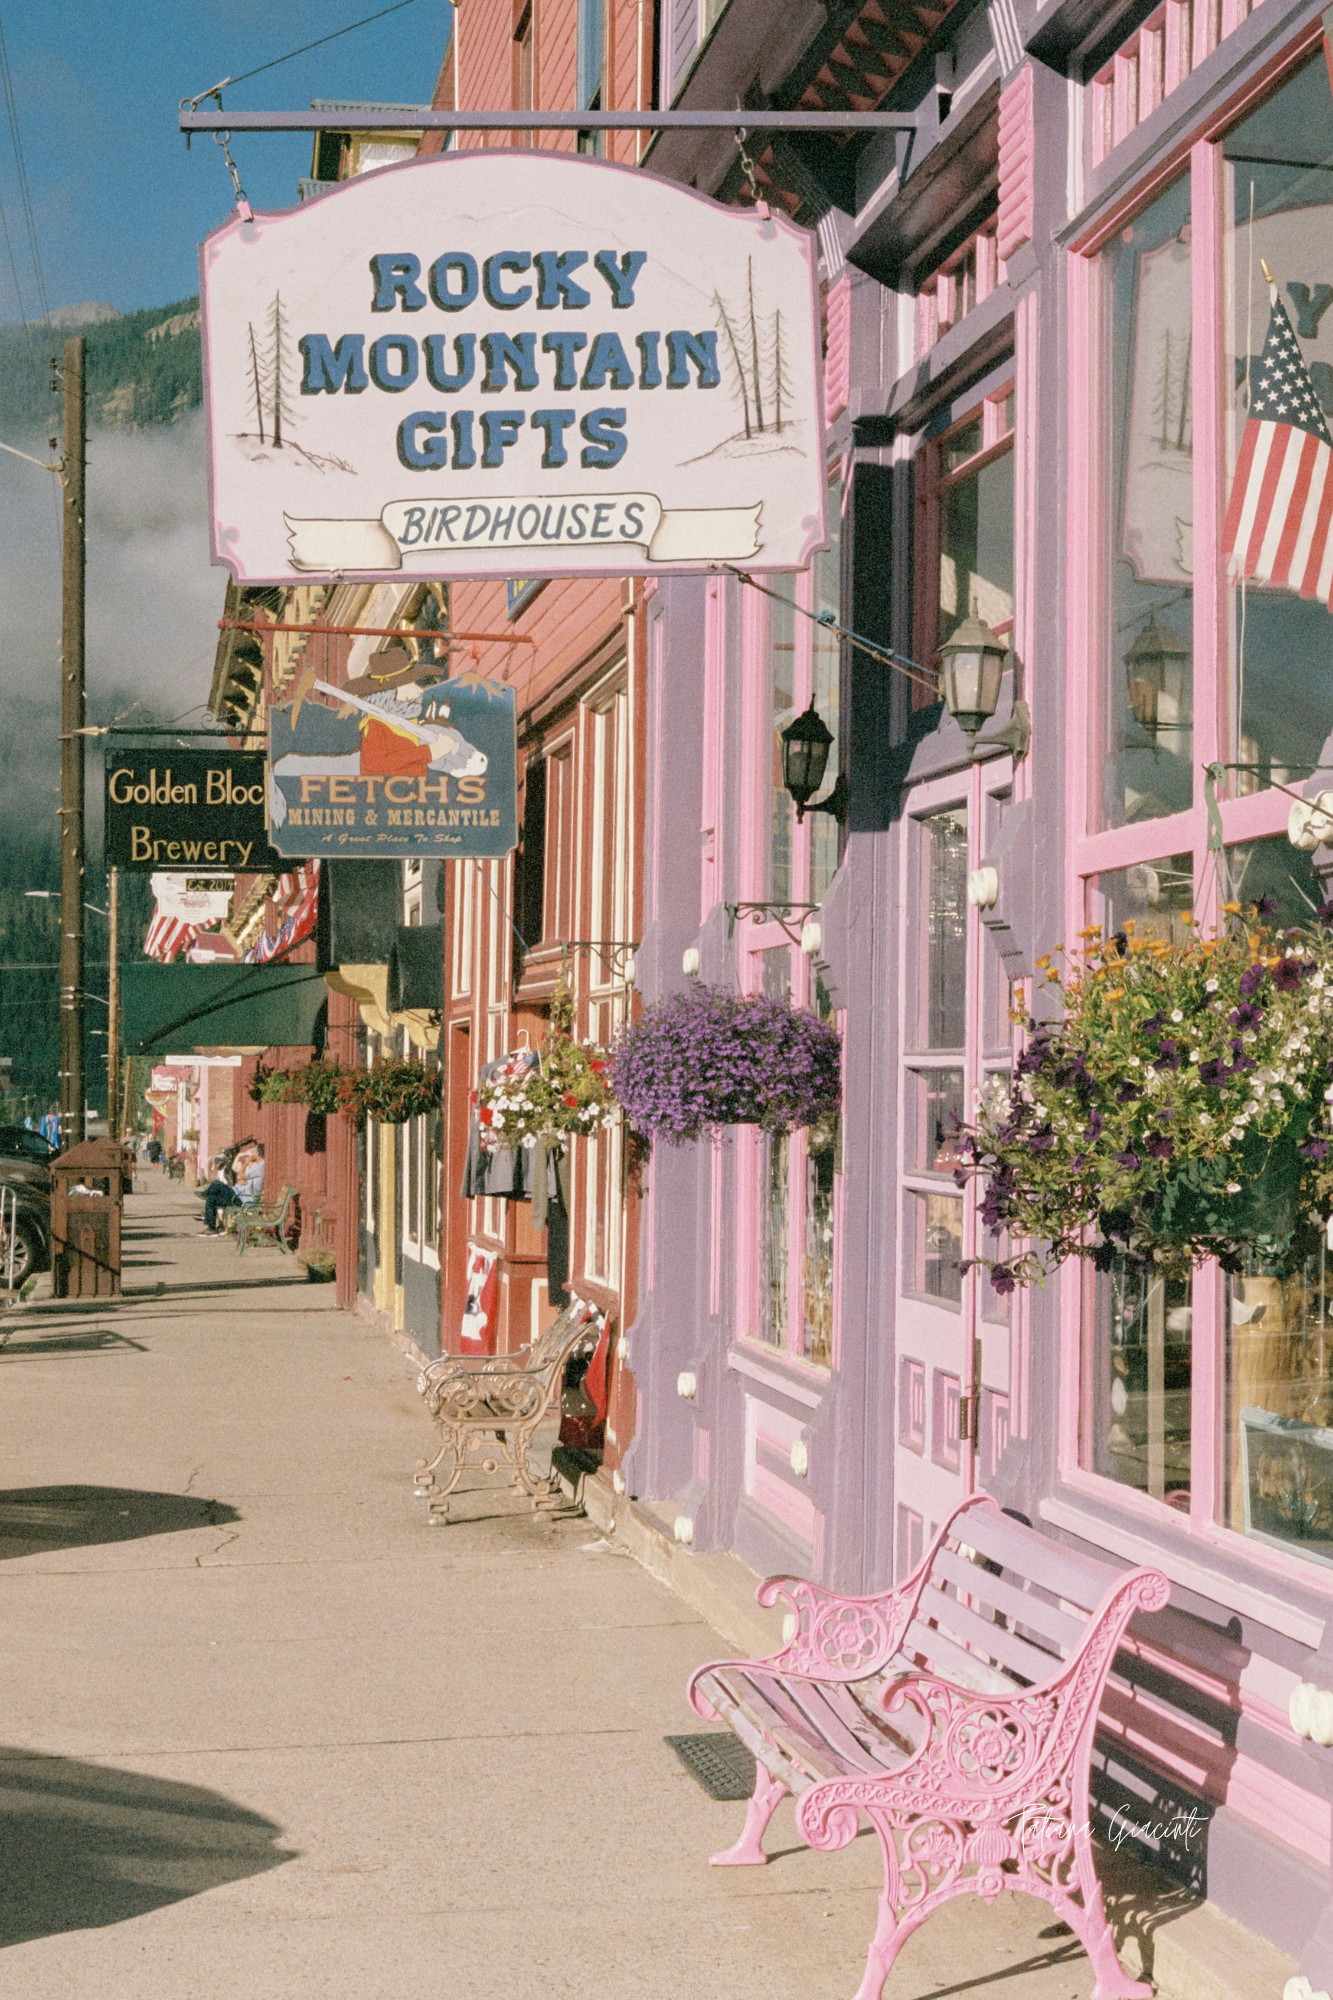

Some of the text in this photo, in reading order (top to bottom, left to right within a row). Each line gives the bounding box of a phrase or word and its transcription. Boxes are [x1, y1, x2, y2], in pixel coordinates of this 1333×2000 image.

[370, 250, 648, 313] ROCKY
[299, 330, 720, 395] MOUNTAIN
[396, 407, 628, 472] GIFTS
[397, 502, 645, 545] BIRDHOUSES
[109, 768, 265, 805] Golden Bloc
[288, 808, 500, 827] MINING & MERCANTILE
[131, 826, 254, 866] Brewery
[321, 833, 462, 845] A Great Place To Shop
[209, 880, 234, 891] 2014
